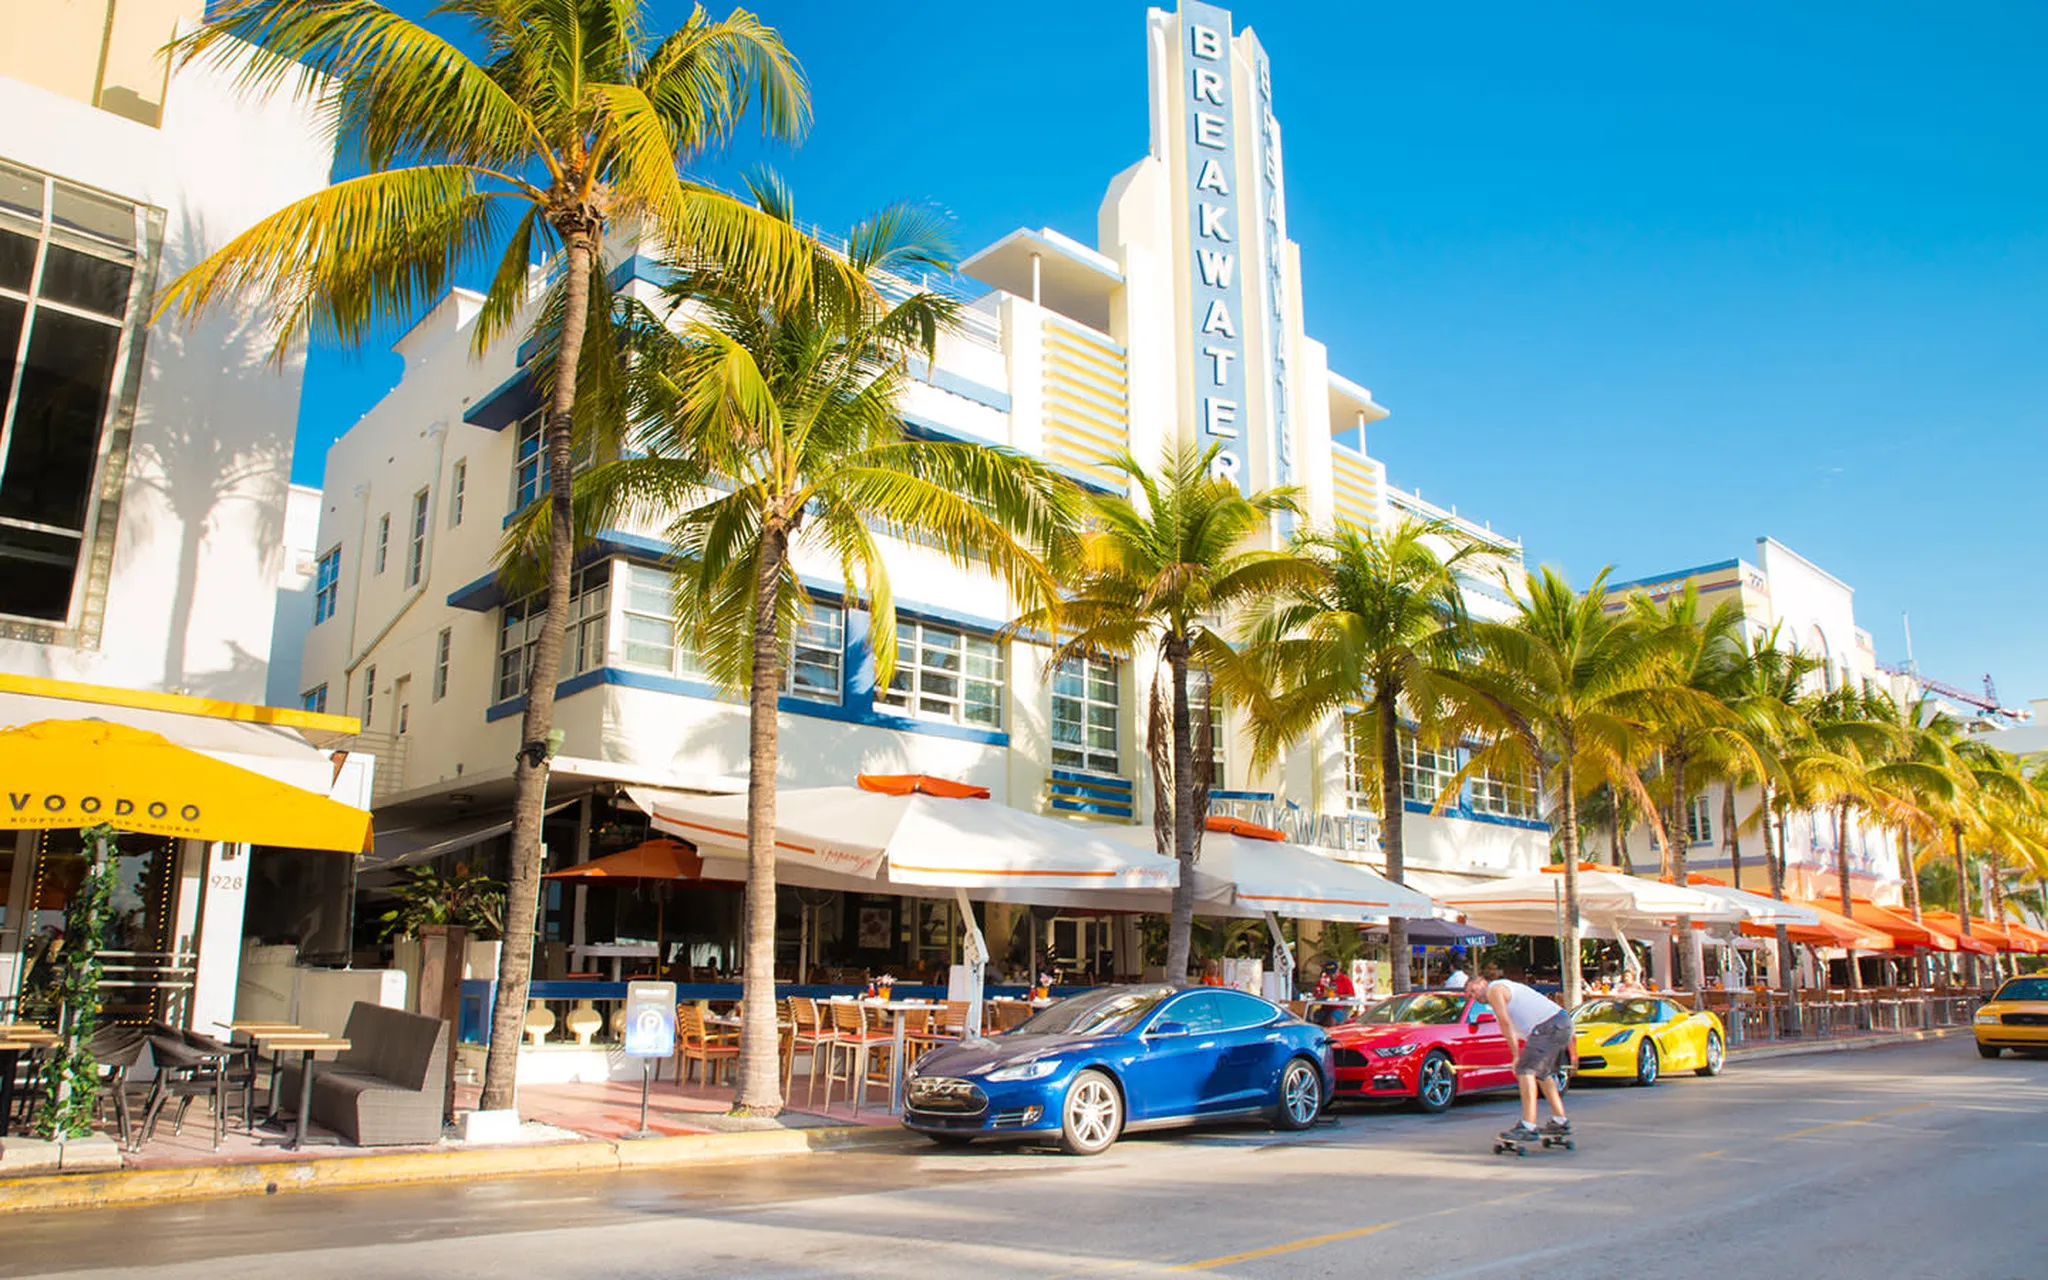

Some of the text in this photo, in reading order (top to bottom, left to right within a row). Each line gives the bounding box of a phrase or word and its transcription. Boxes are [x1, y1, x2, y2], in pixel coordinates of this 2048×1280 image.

[1191, 23, 1241, 490] BREAKWATER
[8, 792, 200, 821] VOODOO
[211, 875, 243, 890] 928
